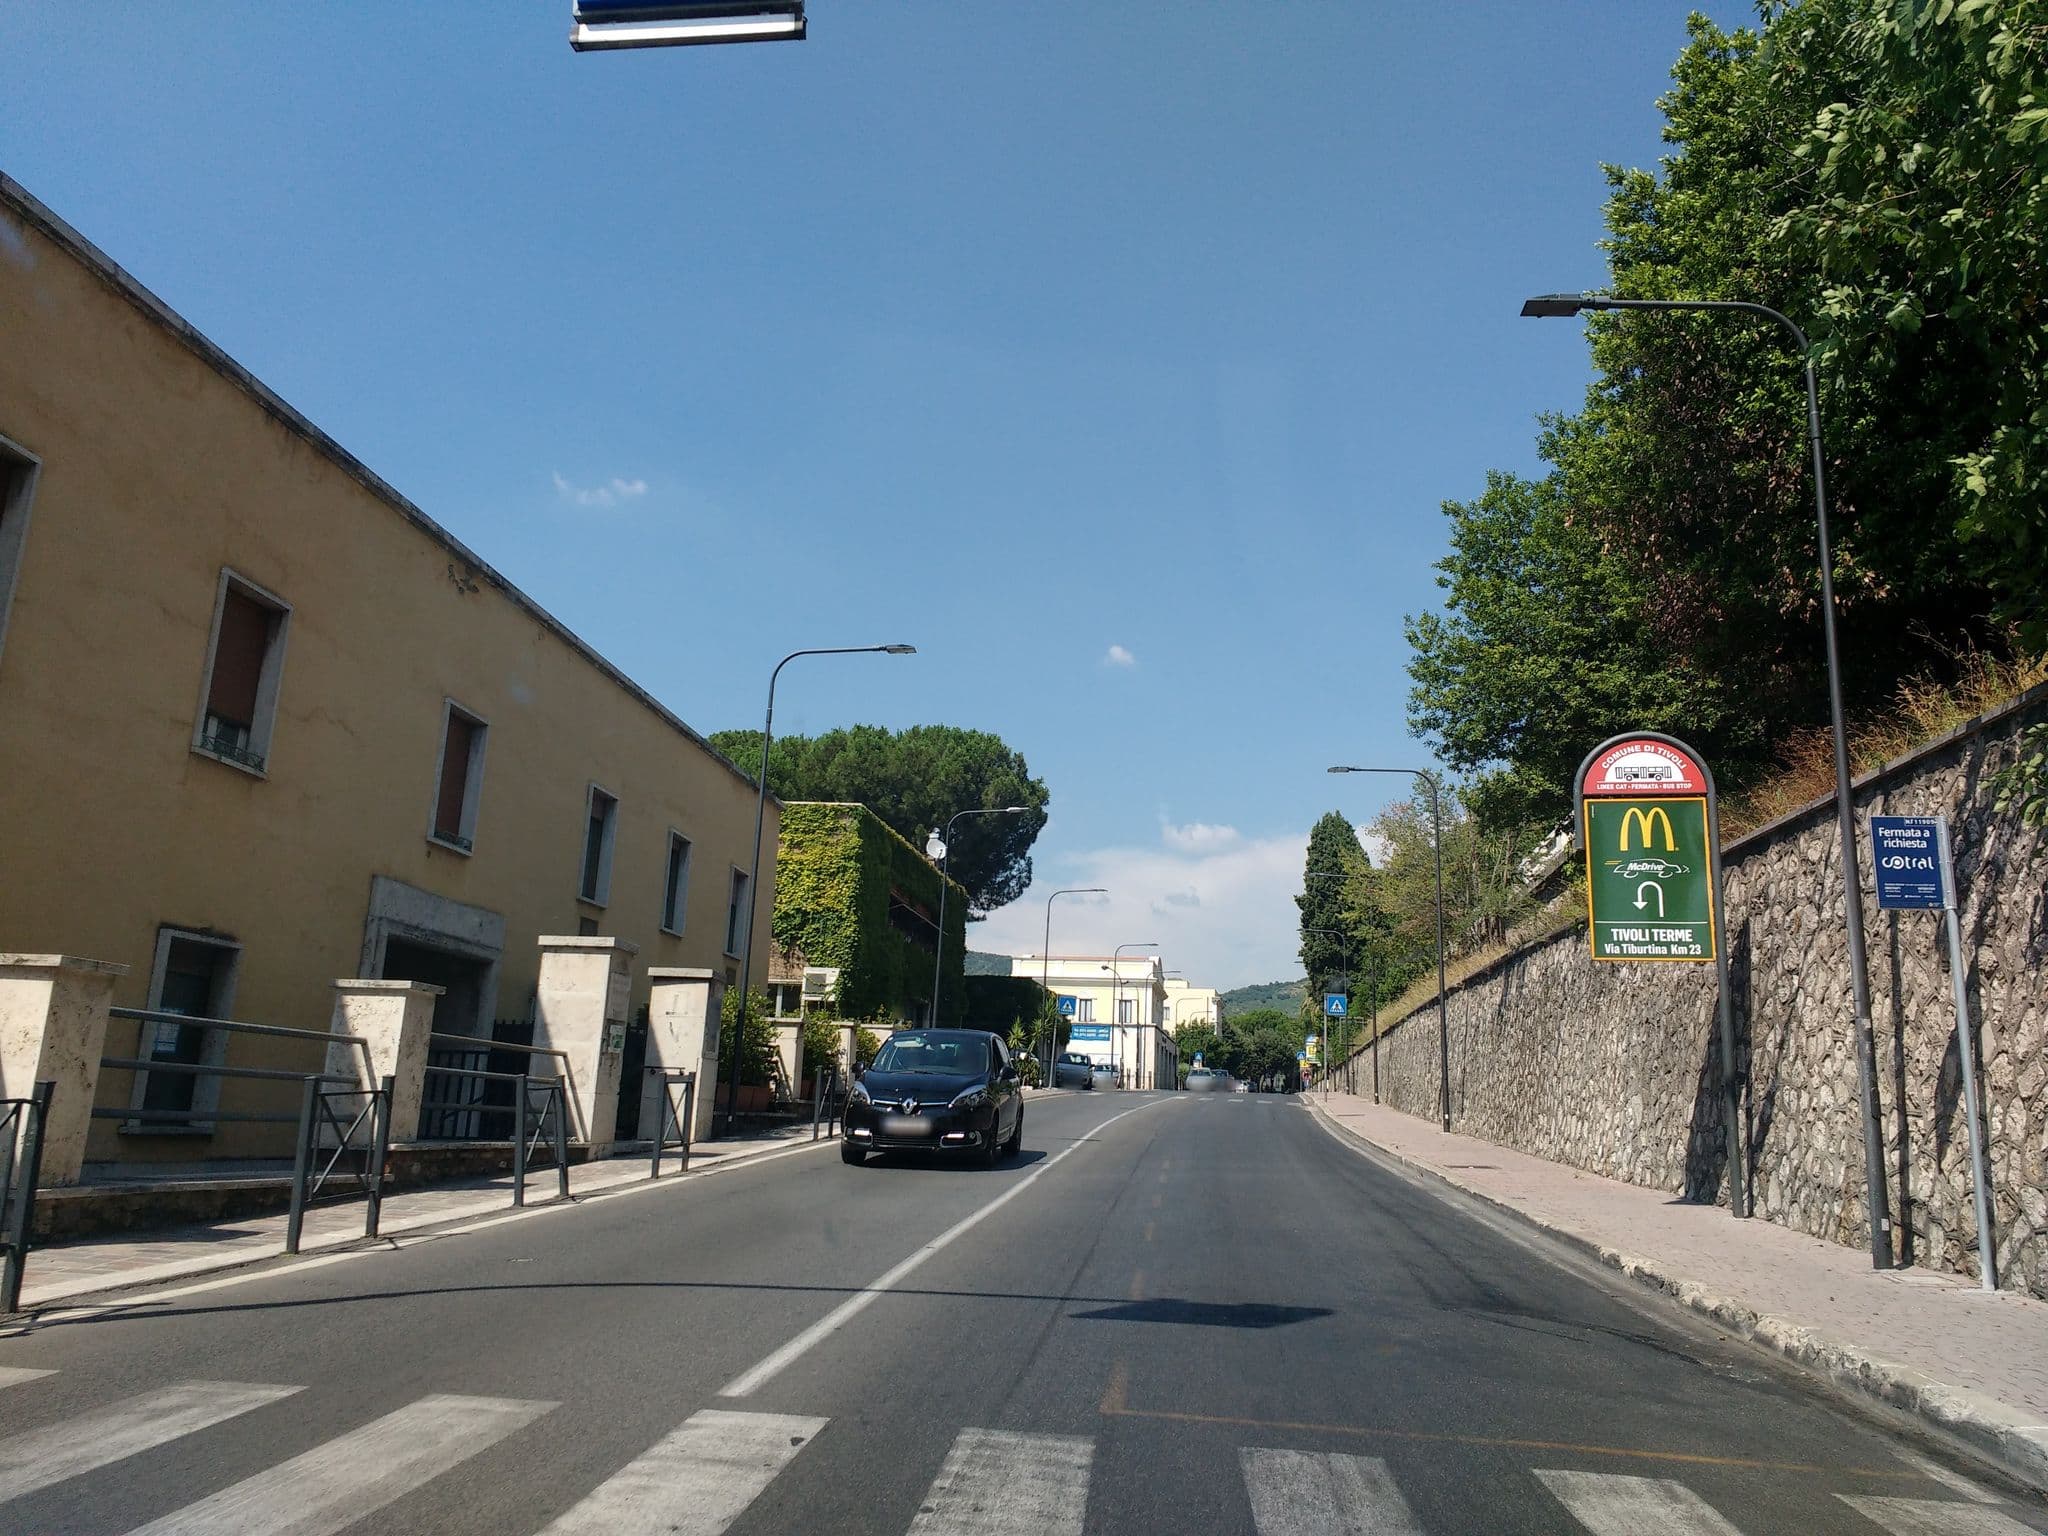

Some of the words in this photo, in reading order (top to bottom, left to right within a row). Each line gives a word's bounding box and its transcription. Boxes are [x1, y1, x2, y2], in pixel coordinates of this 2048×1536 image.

[1601, 745, 1641, 769] COMUNE
[1643, 744, 1655, 753] DI
[1657, 747, 1687, 769] TIVOLI
[1878, 827, 1922, 838] Fermata
[1923, 829, 1930, 837] a
[1883, 838, 1927, 848] richiesta
[1627, 862, 1665, 871] McDrive
[1882, 855, 1935, 870] cotral
[1610, 928, 1650, 942] TIVOLI
[1651, 929, 1693, 942] TERME
[1604, 943, 1621, 954] Via
[1621, 943, 1667, 954] Tiburtina
[1671, 944, 1688, 954] Km
[1689, 944, 1702, 955] 23
